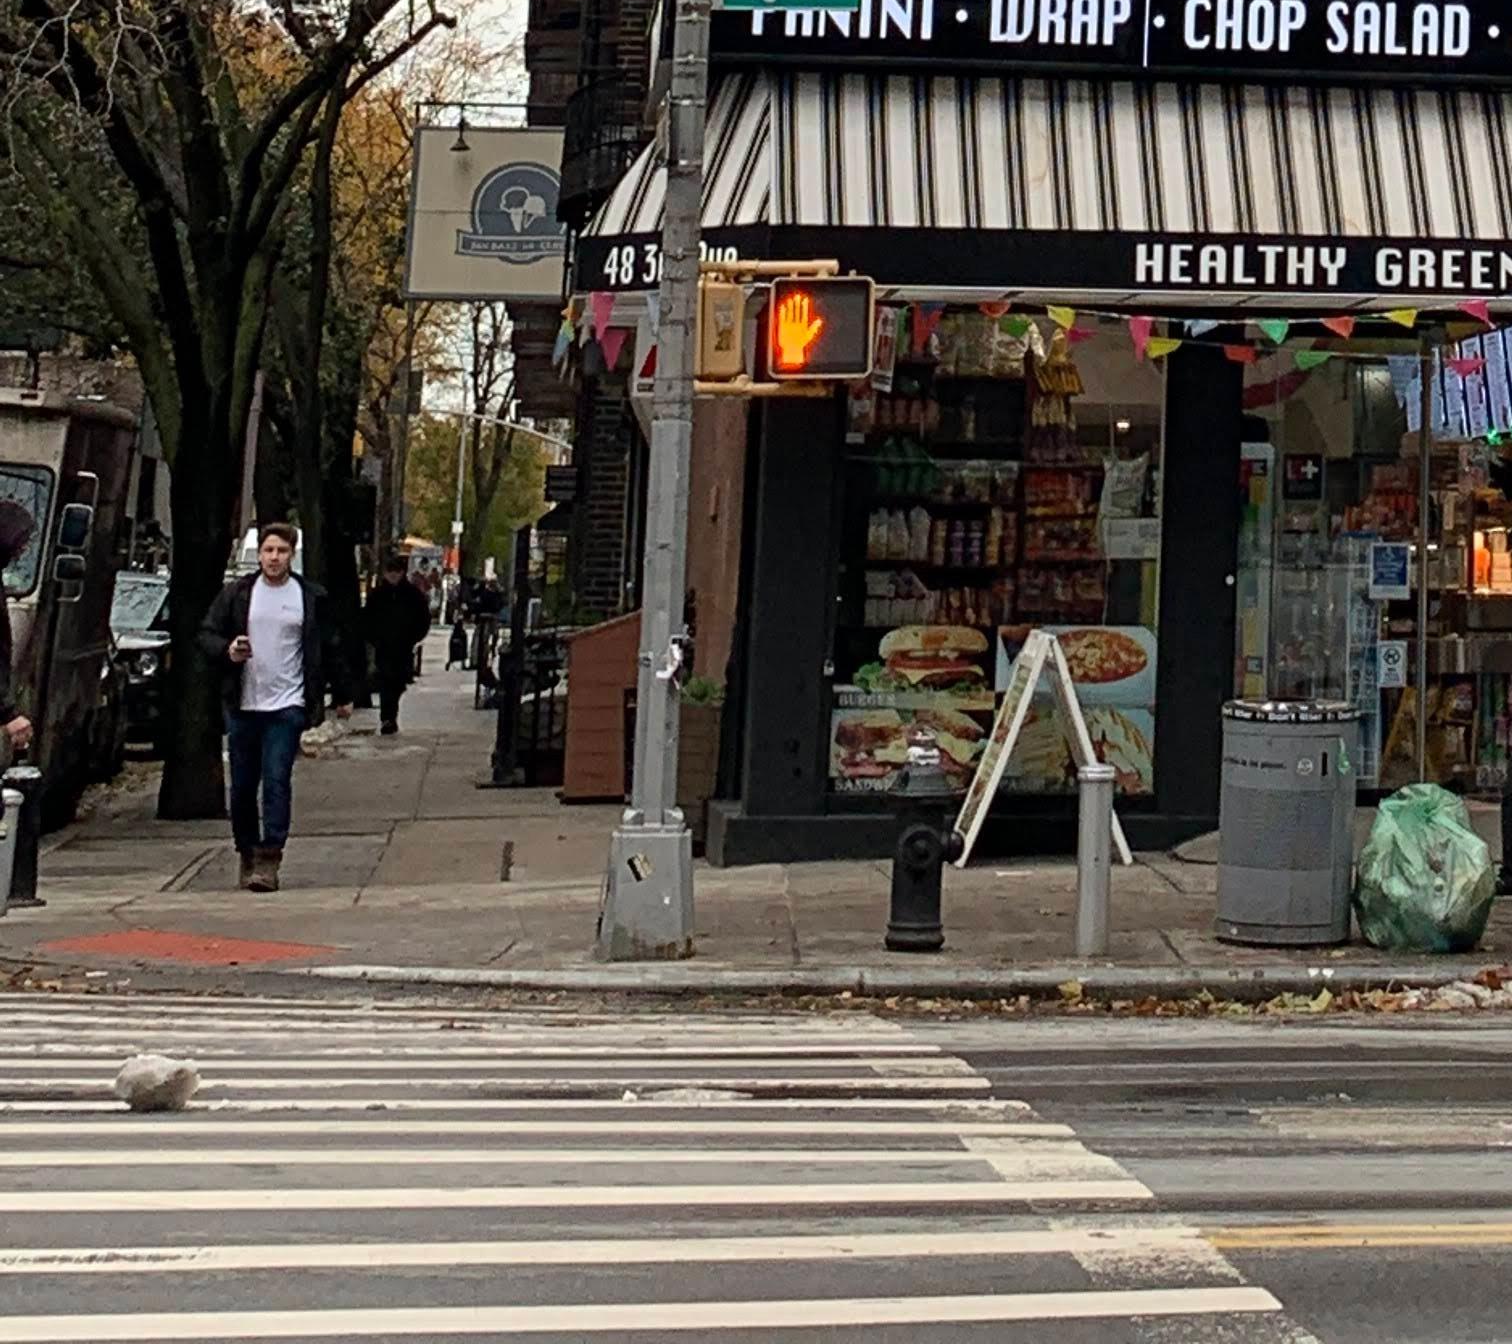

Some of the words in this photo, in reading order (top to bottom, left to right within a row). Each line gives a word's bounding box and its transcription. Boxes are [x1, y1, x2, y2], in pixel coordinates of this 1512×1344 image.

[1326, 1, 1470, 56] SALAD
[604, 246, 635, 285] 48
[1136, 244, 1346, 285] HEALTHY
[838, 692, 897, 708] BURGER
[835, 777, 890, 792] SANDW
